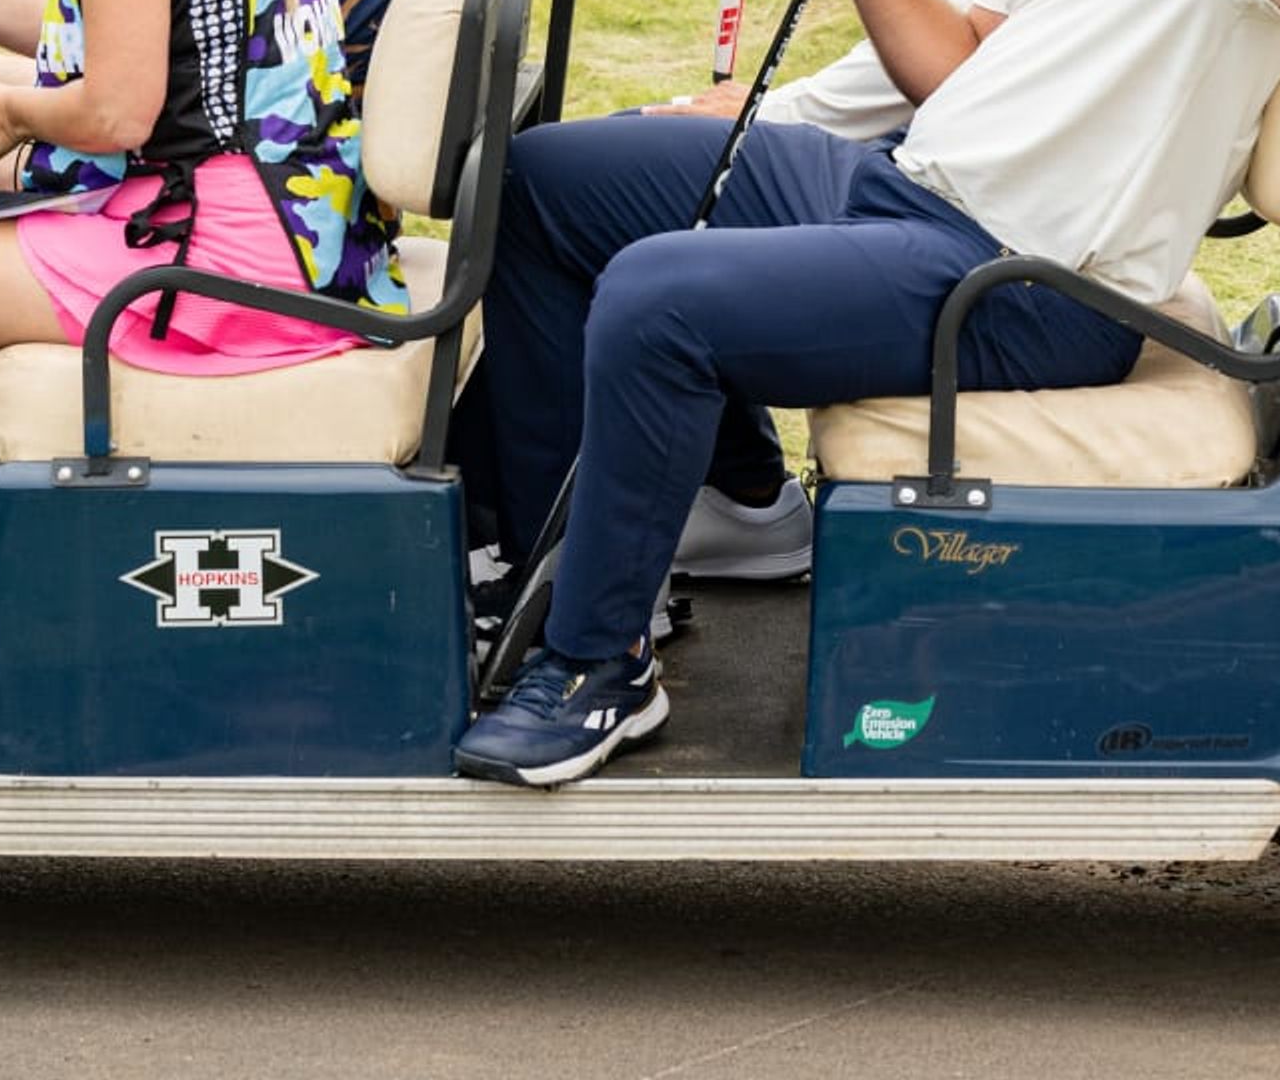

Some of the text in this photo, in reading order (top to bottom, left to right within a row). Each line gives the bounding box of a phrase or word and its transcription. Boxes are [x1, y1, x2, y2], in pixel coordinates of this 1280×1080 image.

[893, 526, 1020, 575] Villager
[178, 572, 260, 586] HOPKINS
[863, 704, 892, 719] Zero
[863, 717, 917, 730] Emission
